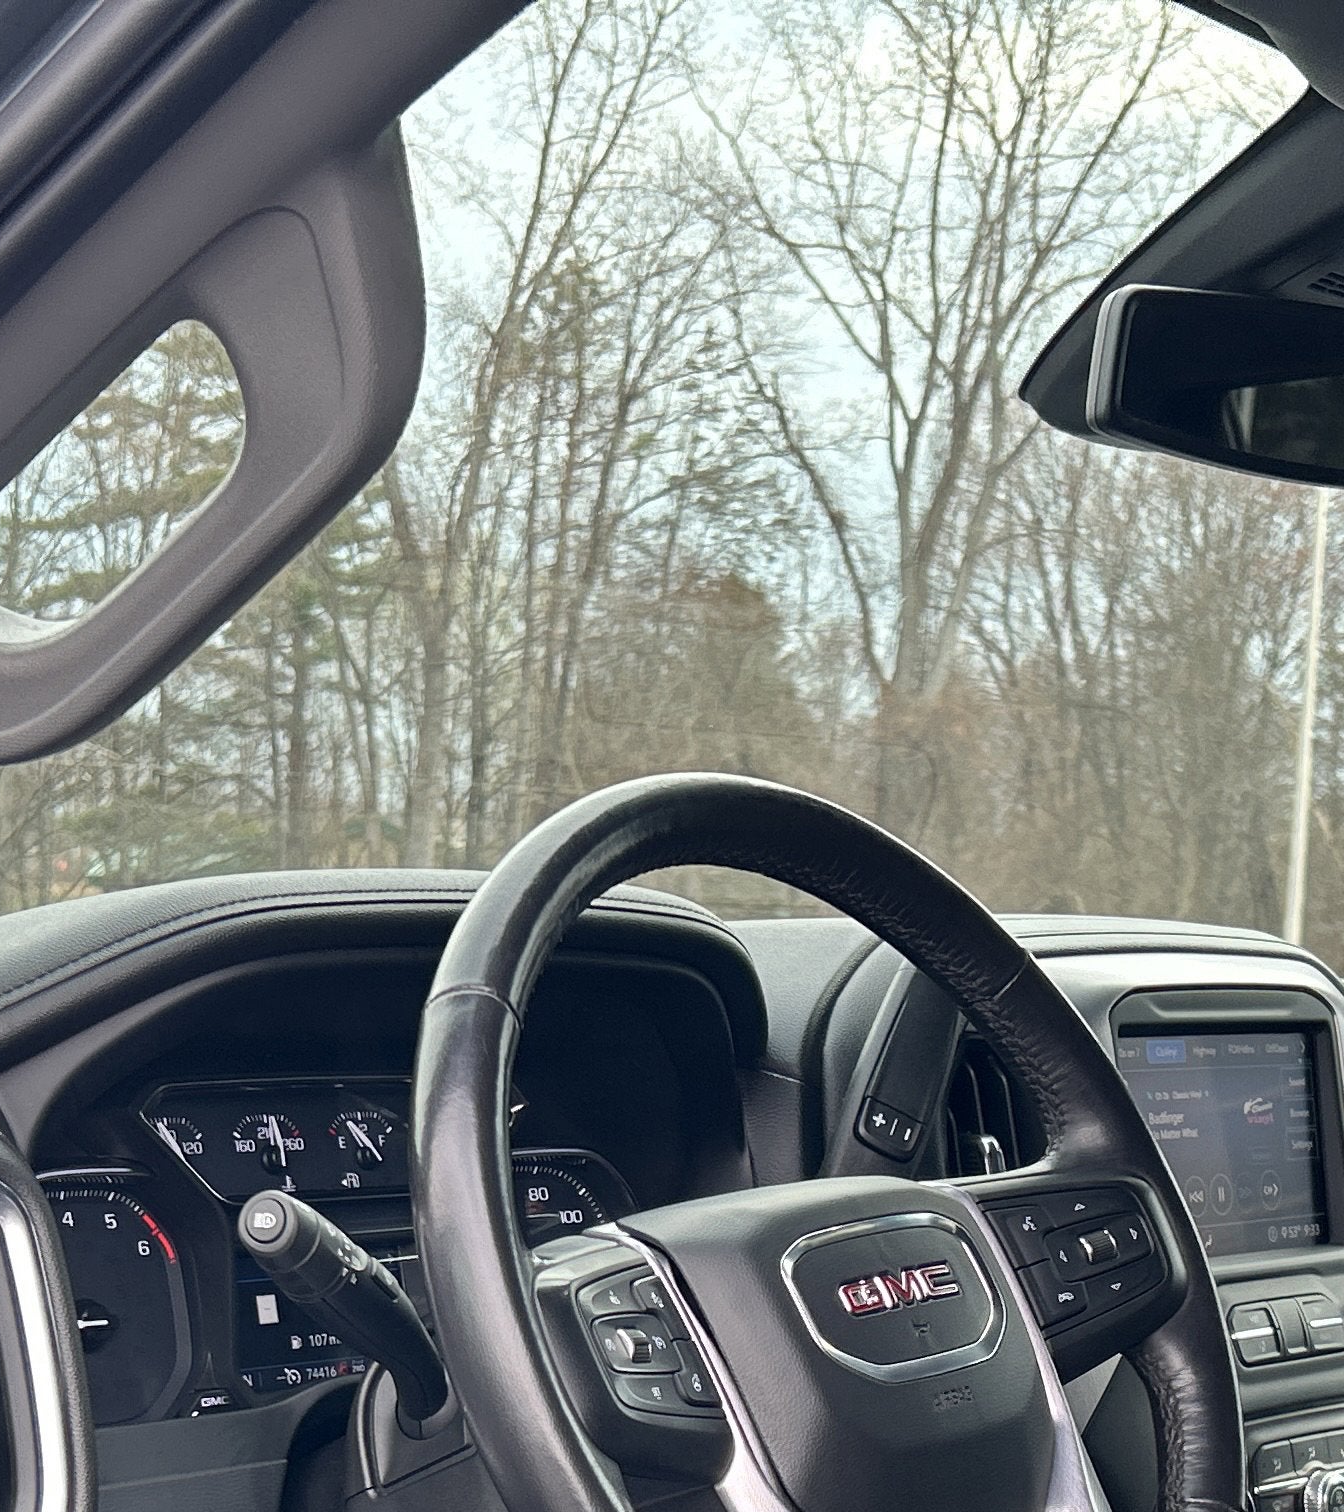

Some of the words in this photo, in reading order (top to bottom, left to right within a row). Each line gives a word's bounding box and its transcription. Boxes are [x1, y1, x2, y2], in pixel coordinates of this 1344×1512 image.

[234, 1140, 255, 1153] 160
[338, 1137, 346, 1149] E
[378, 1135, 386, 1147] F
[182, 1142, 203, 1155] 120
[528, 1187, 549, 1201] 80
[62, 1211, 74, 1227] 4
[104, 1213, 118, 1229] 5
[559, 1210, 583, 1223] 100
[137, 1240, 150, 1256] 6
[838, 1264, 959, 1313] GMC
[306, 1366, 337, 1380] 74416
